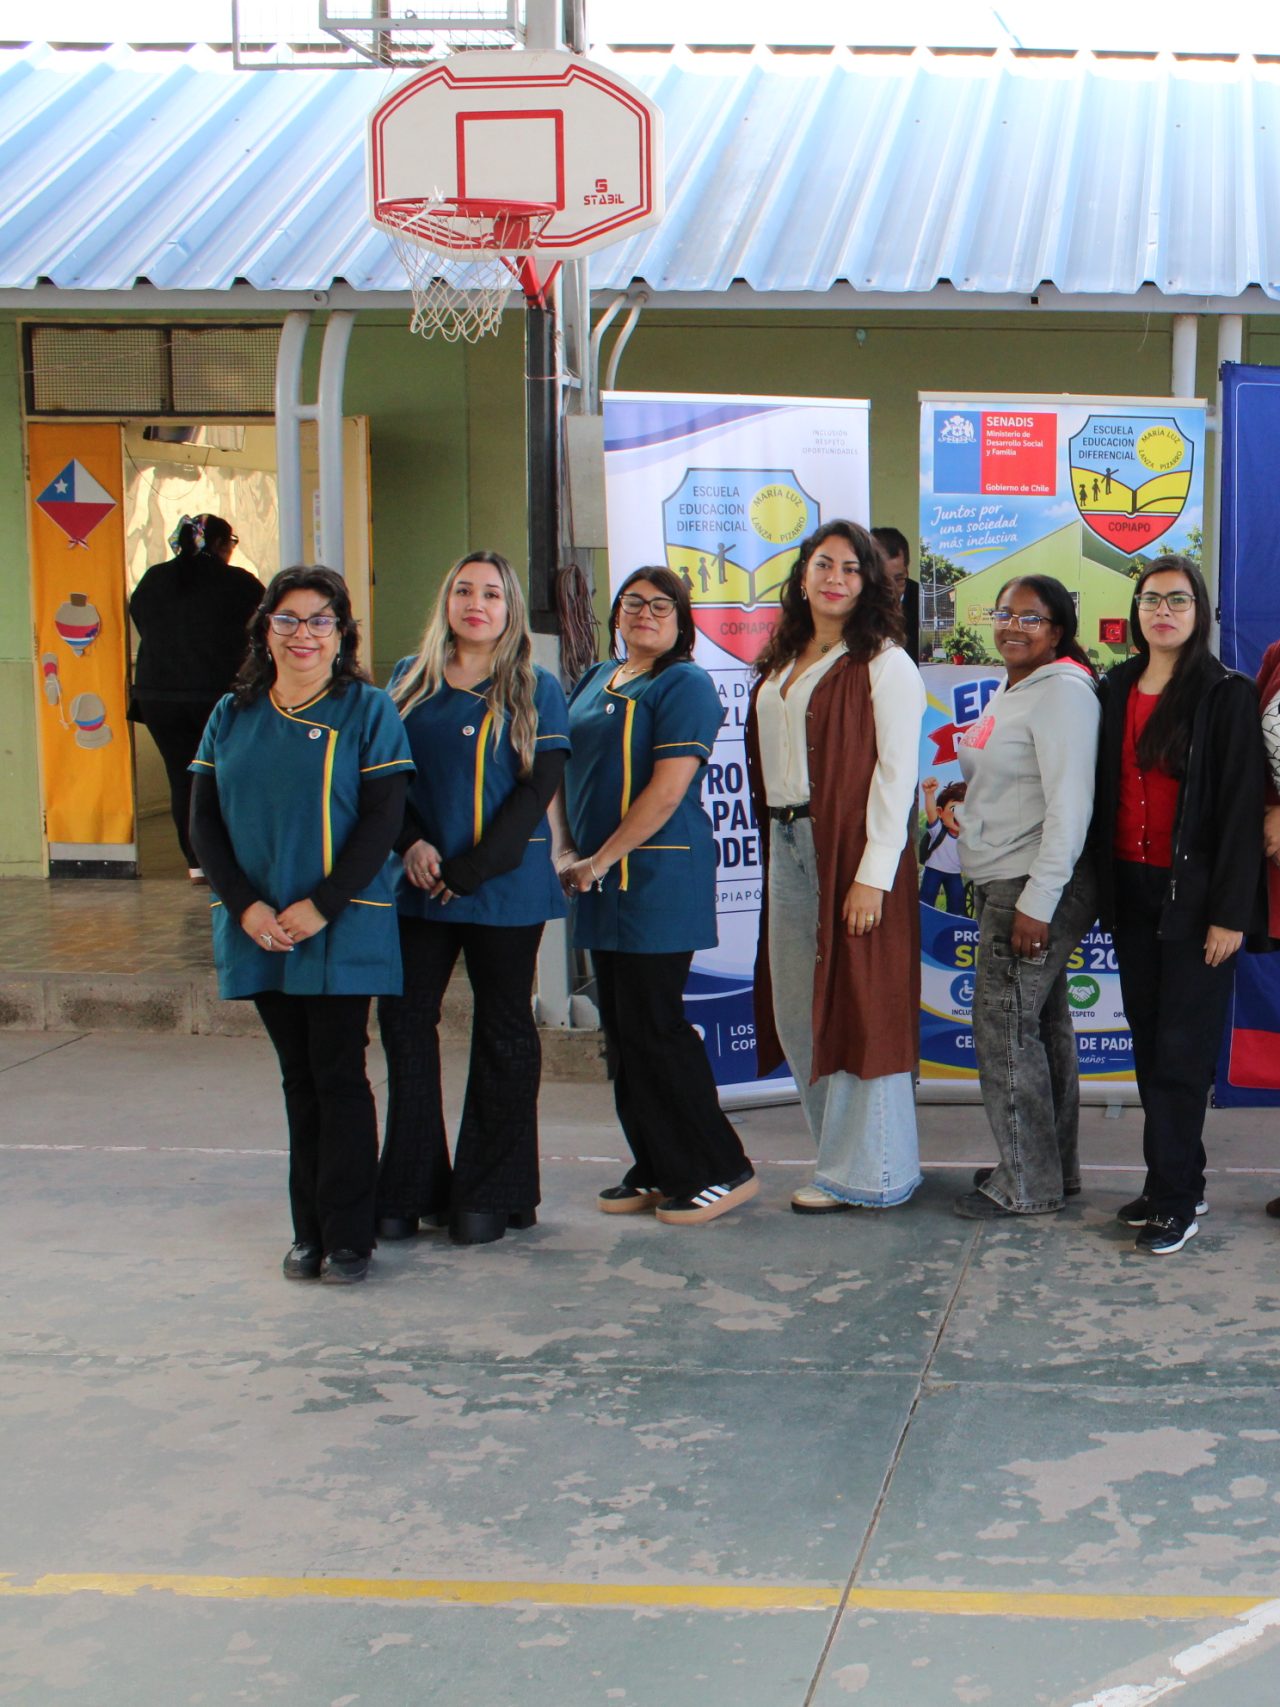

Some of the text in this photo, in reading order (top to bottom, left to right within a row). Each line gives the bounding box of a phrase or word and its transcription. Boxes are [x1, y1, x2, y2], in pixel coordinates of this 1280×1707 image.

[986, 416, 1034, 427] SENADIS
[986, 430, 1021, 438] Ministerio
[1093, 425, 1134, 435] ESCUELA
[986, 439, 1044, 448] Desarrollo Social
[1082, 437, 1135, 448] EDUCACION
[1166, 431, 1180, 444] LUZ
[1078, 449, 1136, 461] DIFERENCIAL
[1138, 450, 1183, 470] LANZA PIZARRO
[693, 486, 740, 497] ESCUELA
[985, 483, 1050, 492] Gobierno de Chile
[753, 487, 802, 508] MARÍA LUZ
[679, 503, 745, 515] EDUCACION
[930, 504, 1003, 526] Juntos por
[677, 520, 748, 532] DIFERENCIAL
[751, 516, 806, 542] LANZA PIZARRO
[940, 513, 1018, 535] una sociedad
[1108, 522, 1151, 532] COPIAPO
[938, 530, 1017, 549] más inclusiva
[1079, 1037, 1097, 1050] DE
[1077, 1054, 1106, 1064] ueños
